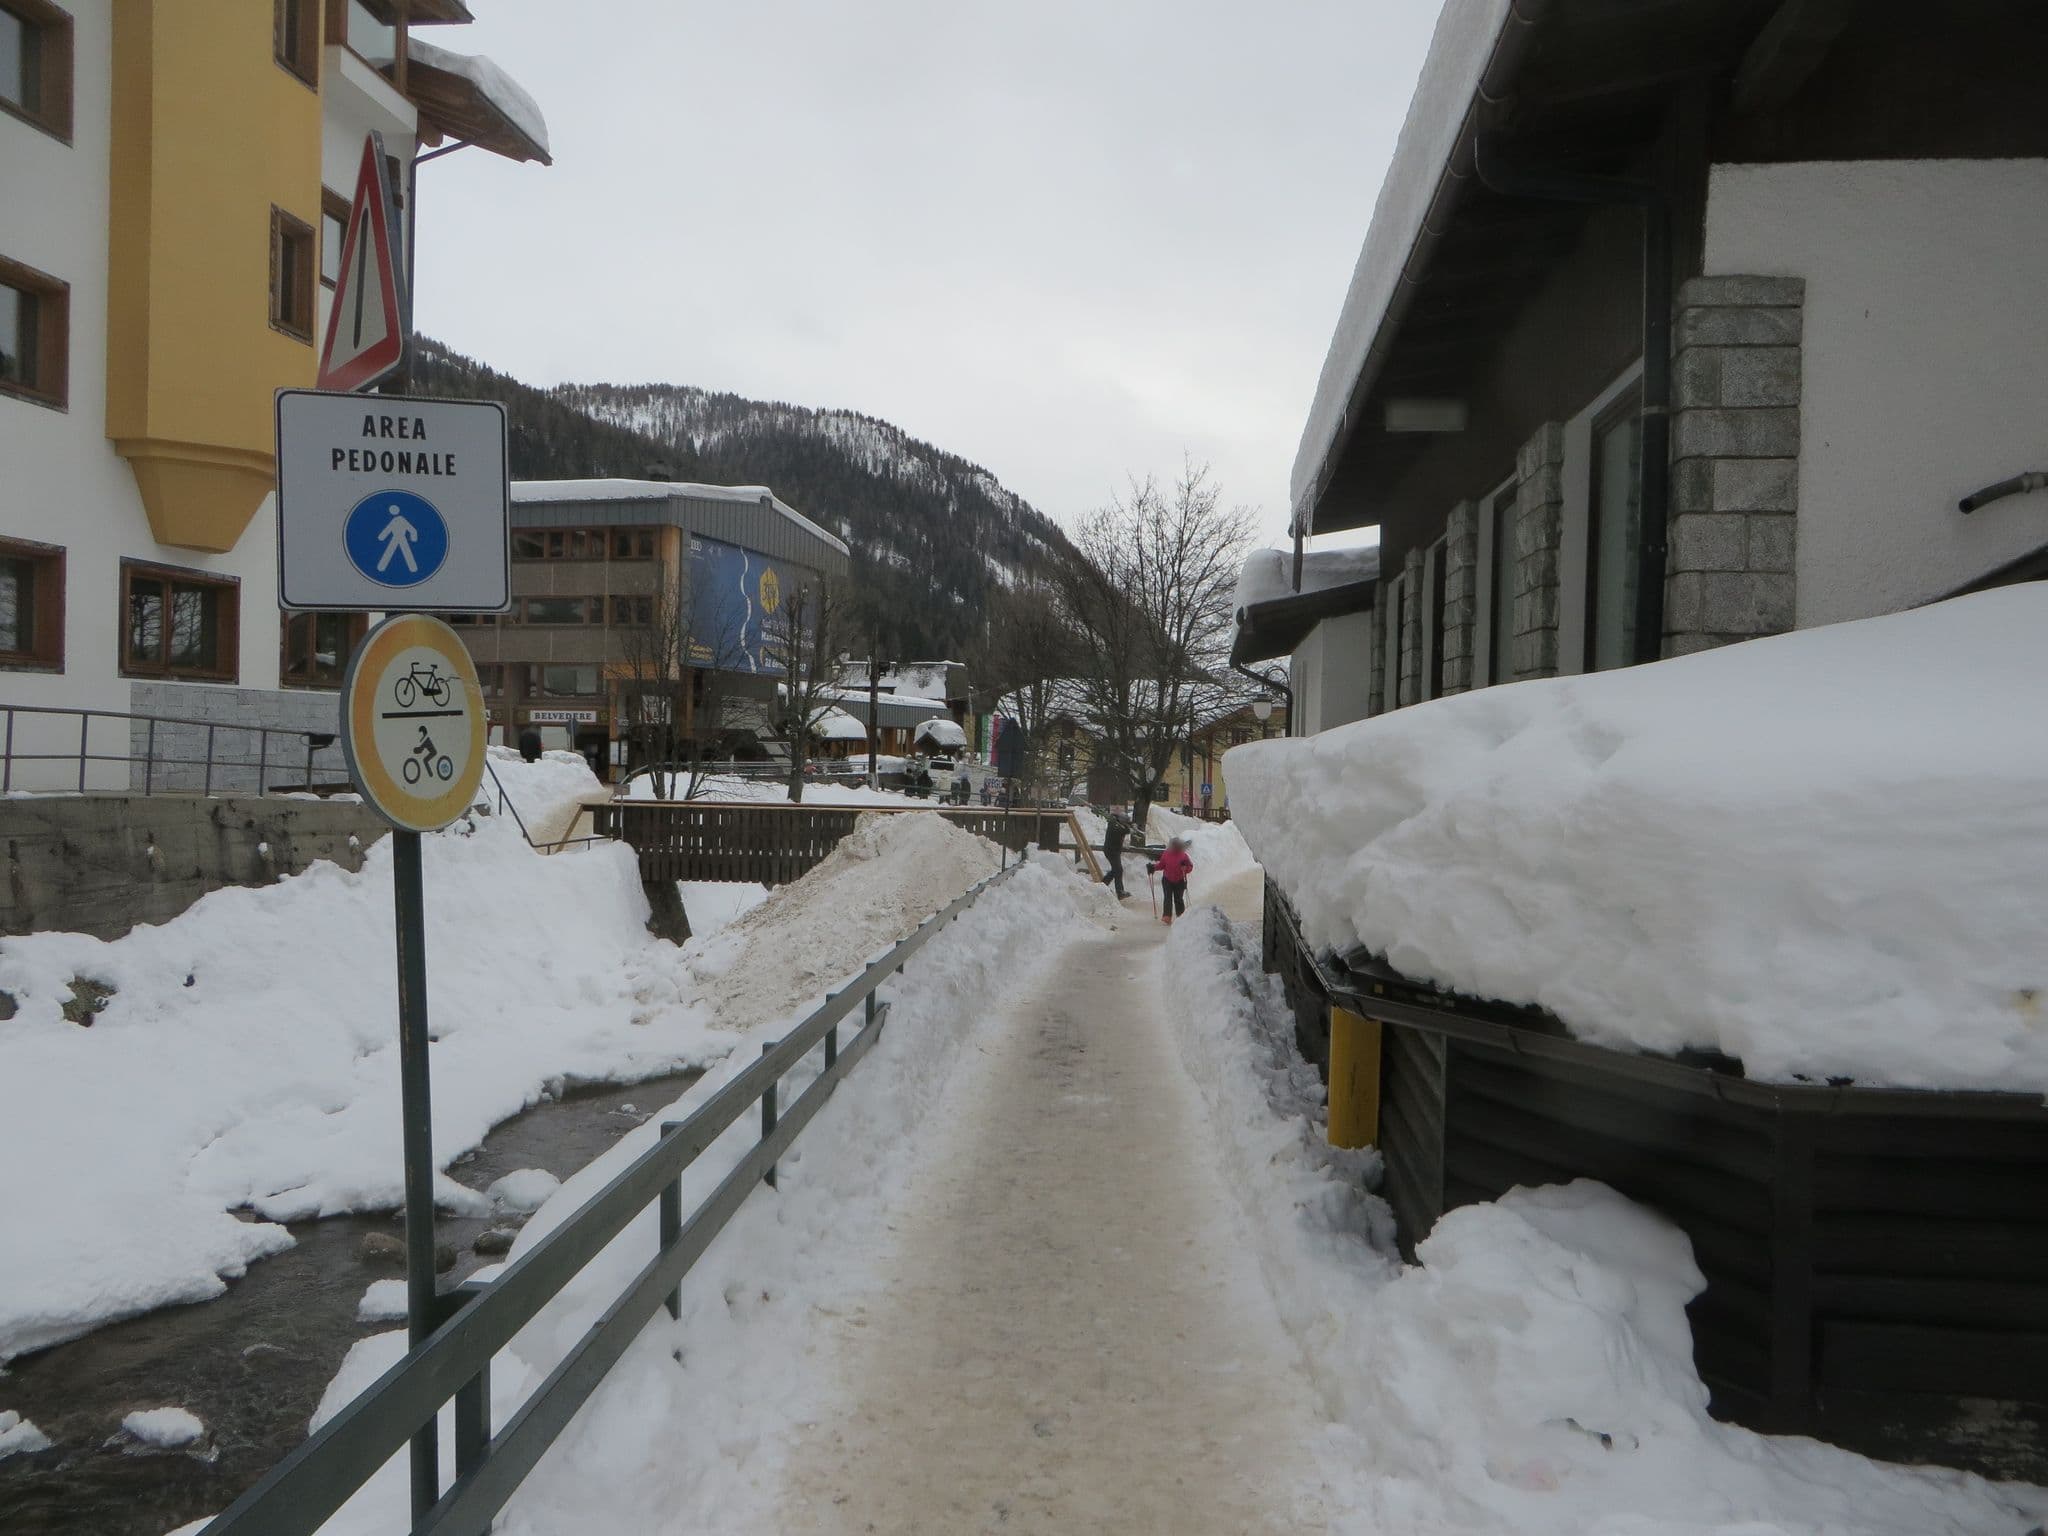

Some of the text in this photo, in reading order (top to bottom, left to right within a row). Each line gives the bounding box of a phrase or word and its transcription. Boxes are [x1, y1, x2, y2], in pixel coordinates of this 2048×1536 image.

[362, 415, 427, 441] AREA
[331, 448, 457, 476] PEDONALE
[534, 711, 592, 721] BELVEDERE
